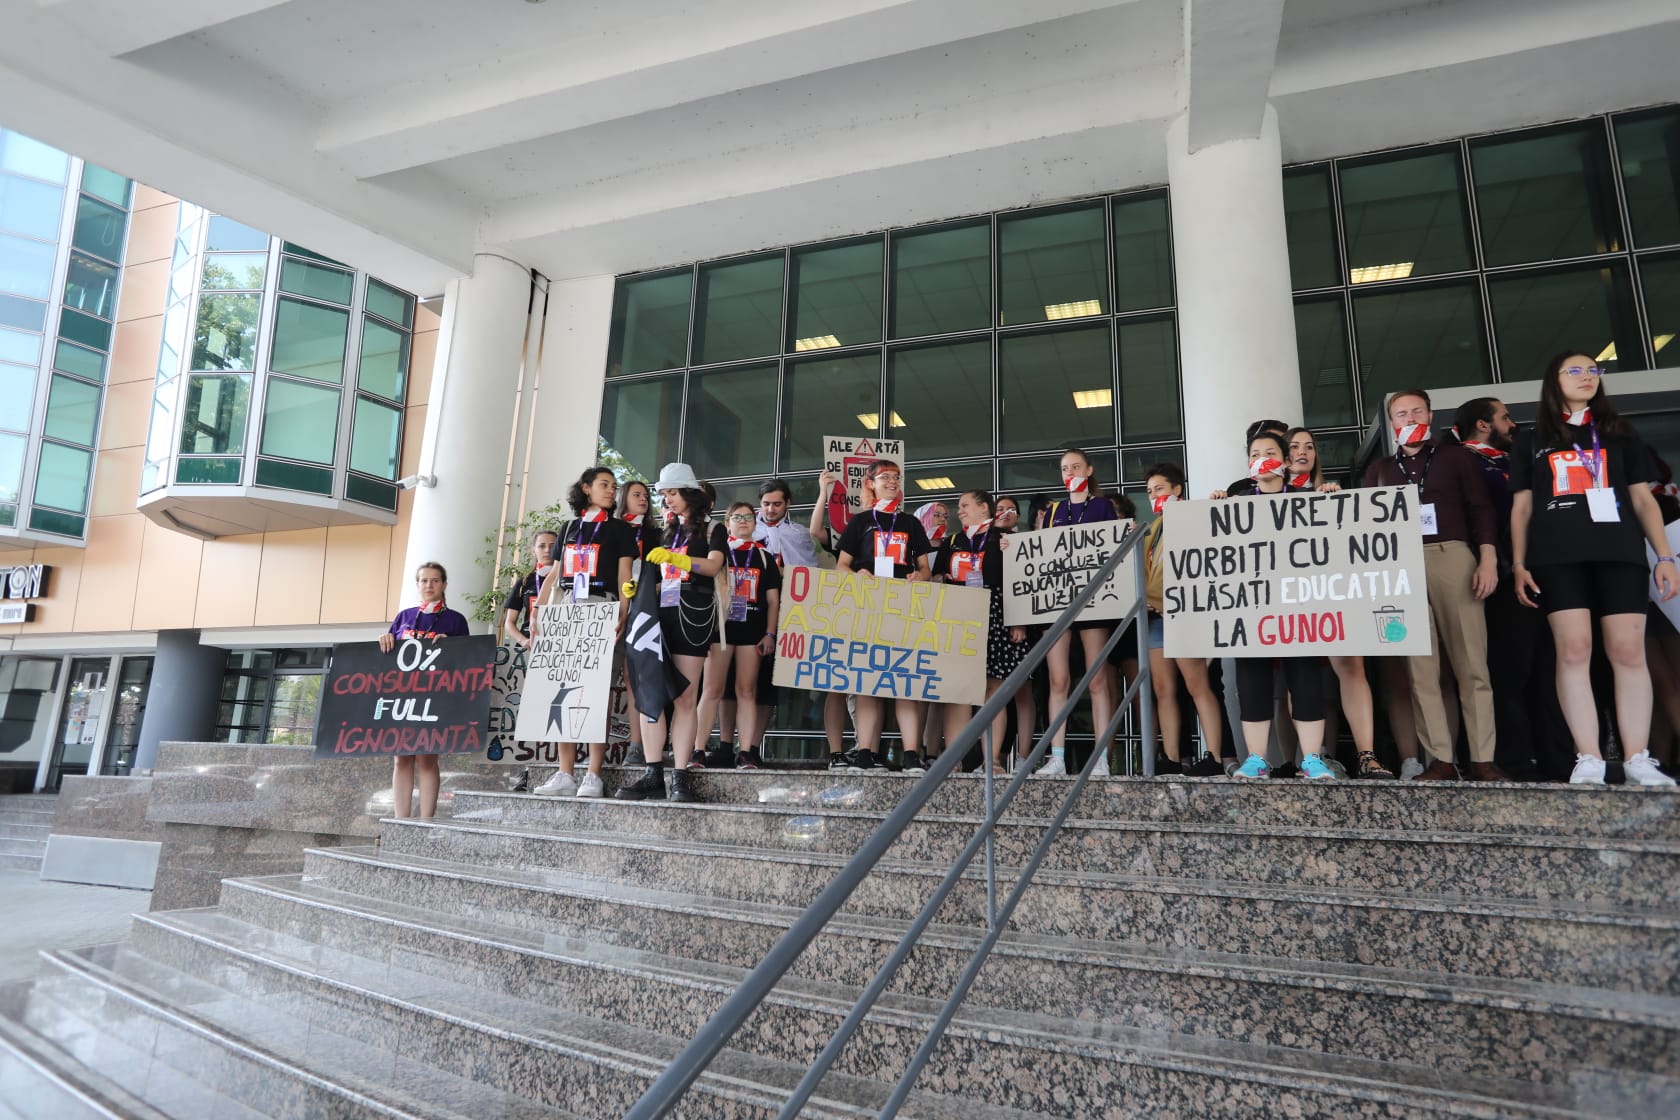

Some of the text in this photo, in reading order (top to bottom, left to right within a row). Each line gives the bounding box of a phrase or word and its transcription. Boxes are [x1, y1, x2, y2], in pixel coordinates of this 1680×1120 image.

[826, 461, 842, 472] DE
[848, 466, 867, 477] EDU
[1210, 487, 1409, 537] NU VREȚI SĂ
[1015, 536, 1044, 563] AM
[1169, 532, 1398, 580] VORBIȚI CU NOI
[1024, 563, 1035, 576] O
[816, 569, 947, 621] PARERI
[1165, 569, 1412, 619] ȘI LĂSAȚI EDUCAȚIA
[541, 605, 562, 622] NU
[598, 602, 616, 621] SĂ
[588, 621, 604, 637] CU
[779, 603, 983, 657] ASCULTATE
[1214, 611, 1346, 648] LA GUNOI
[396, 638, 442, 672] 0%
[533, 638, 553, 654] NOI
[778, 632, 938, 676] 100 DE POZE
[547, 668, 582, 683] GUNOI
[583, 655, 600, 670] LA
[333, 664, 495, 701] CONSULTANȚĂ
[794, 662, 942, 700] POSTATE
[373, 697, 439, 722] FULL
